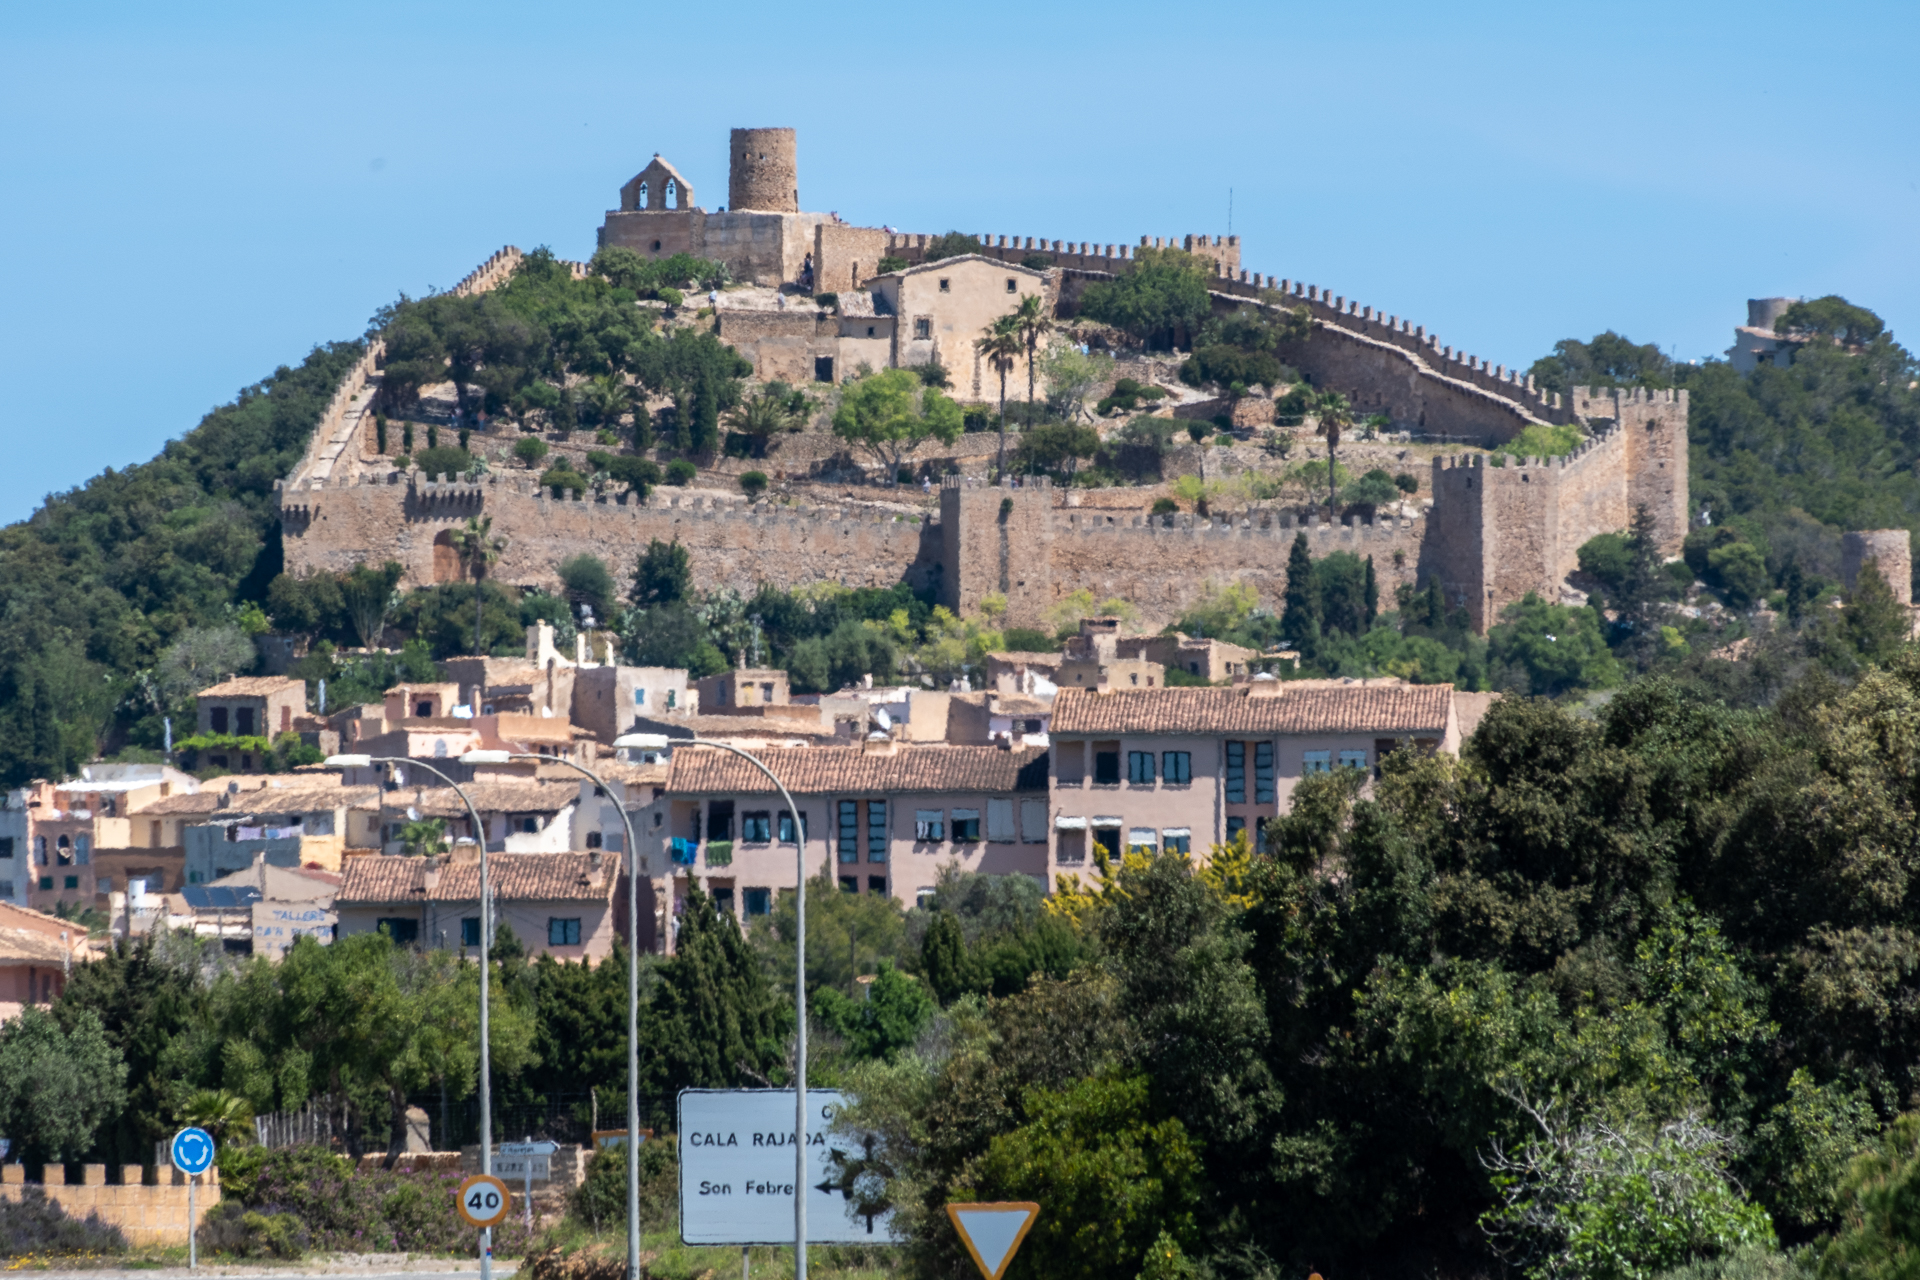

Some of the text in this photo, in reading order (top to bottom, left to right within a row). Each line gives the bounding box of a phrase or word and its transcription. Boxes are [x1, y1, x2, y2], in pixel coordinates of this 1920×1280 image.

[690, 1131, 738, 1147] CALA
[699, 1180, 732, 1196] Son
[467, 1191, 500, 1211] 40
